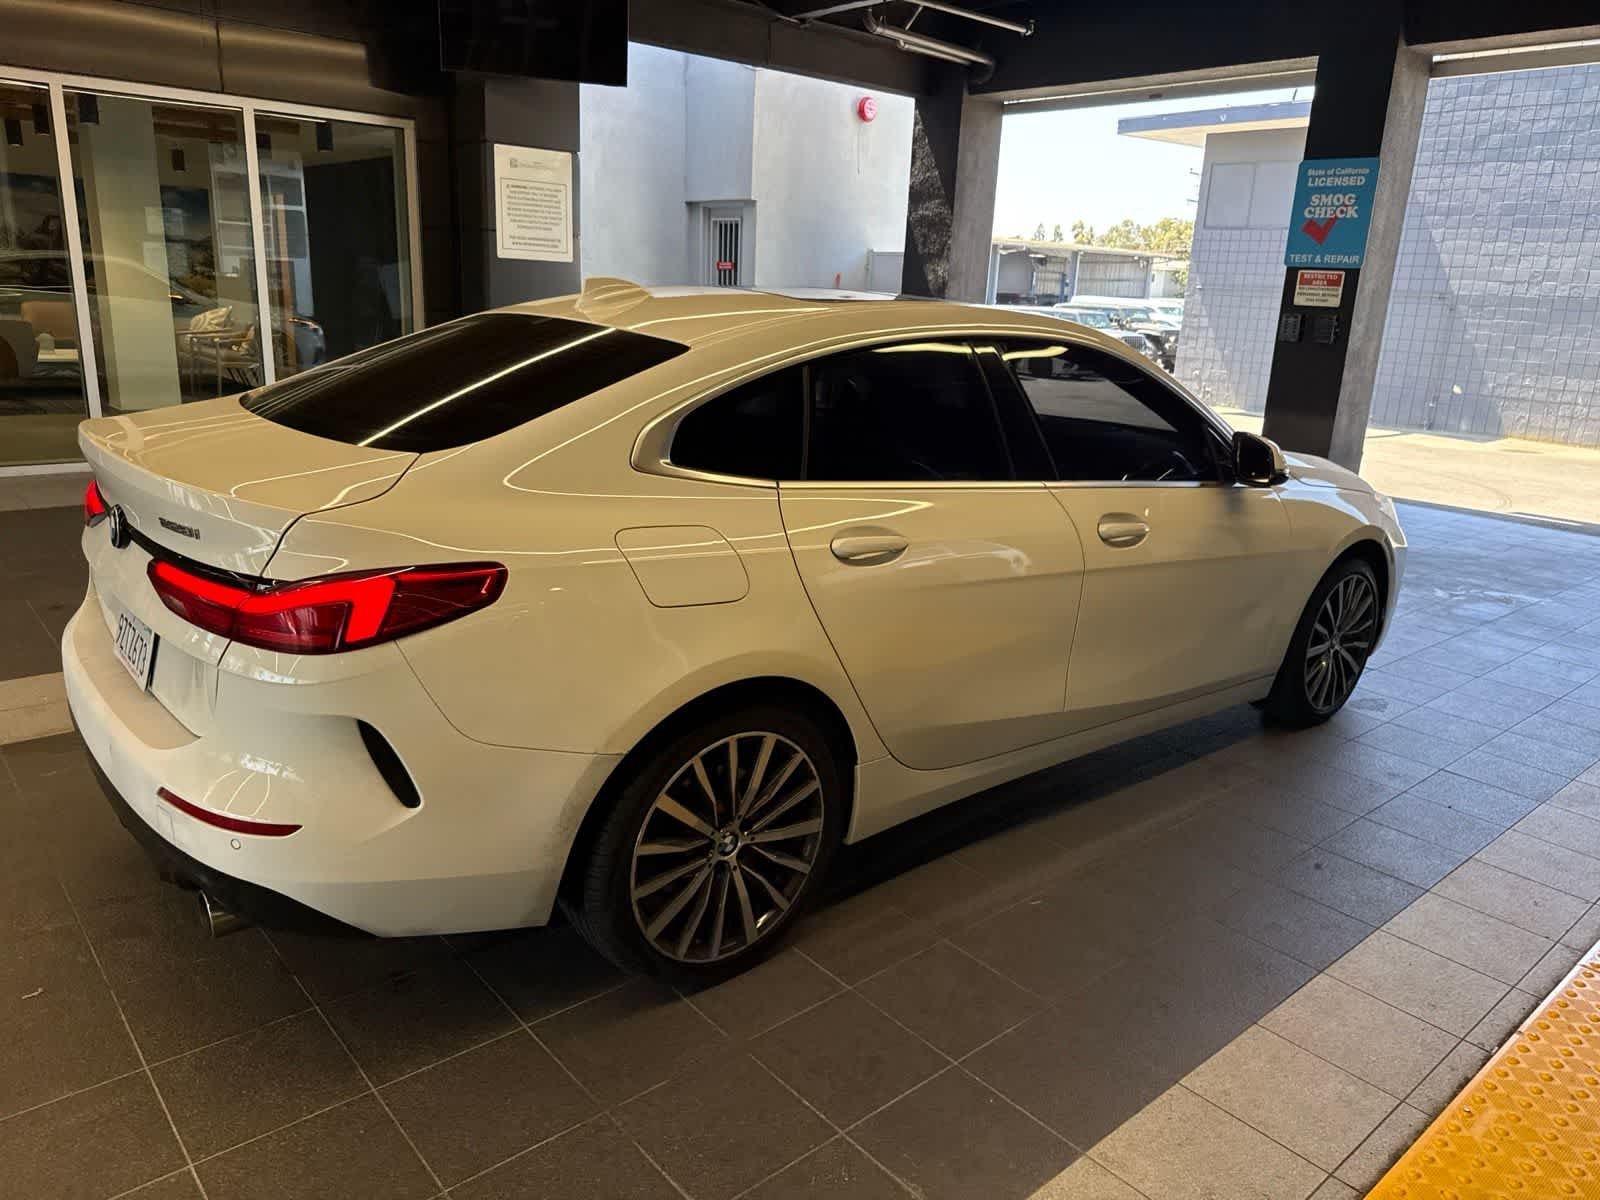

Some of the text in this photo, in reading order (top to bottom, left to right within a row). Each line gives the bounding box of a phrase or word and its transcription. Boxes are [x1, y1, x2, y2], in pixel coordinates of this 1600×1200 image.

[1308, 167, 1370, 176] State of California
[1308, 176, 1366, 187] LICENSED
[1310, 193, 1357, 206] SMOG
[1304, 206, 1359, 218] CHECK
[1290, 254, 1360, 264] TEST & REPAIR
